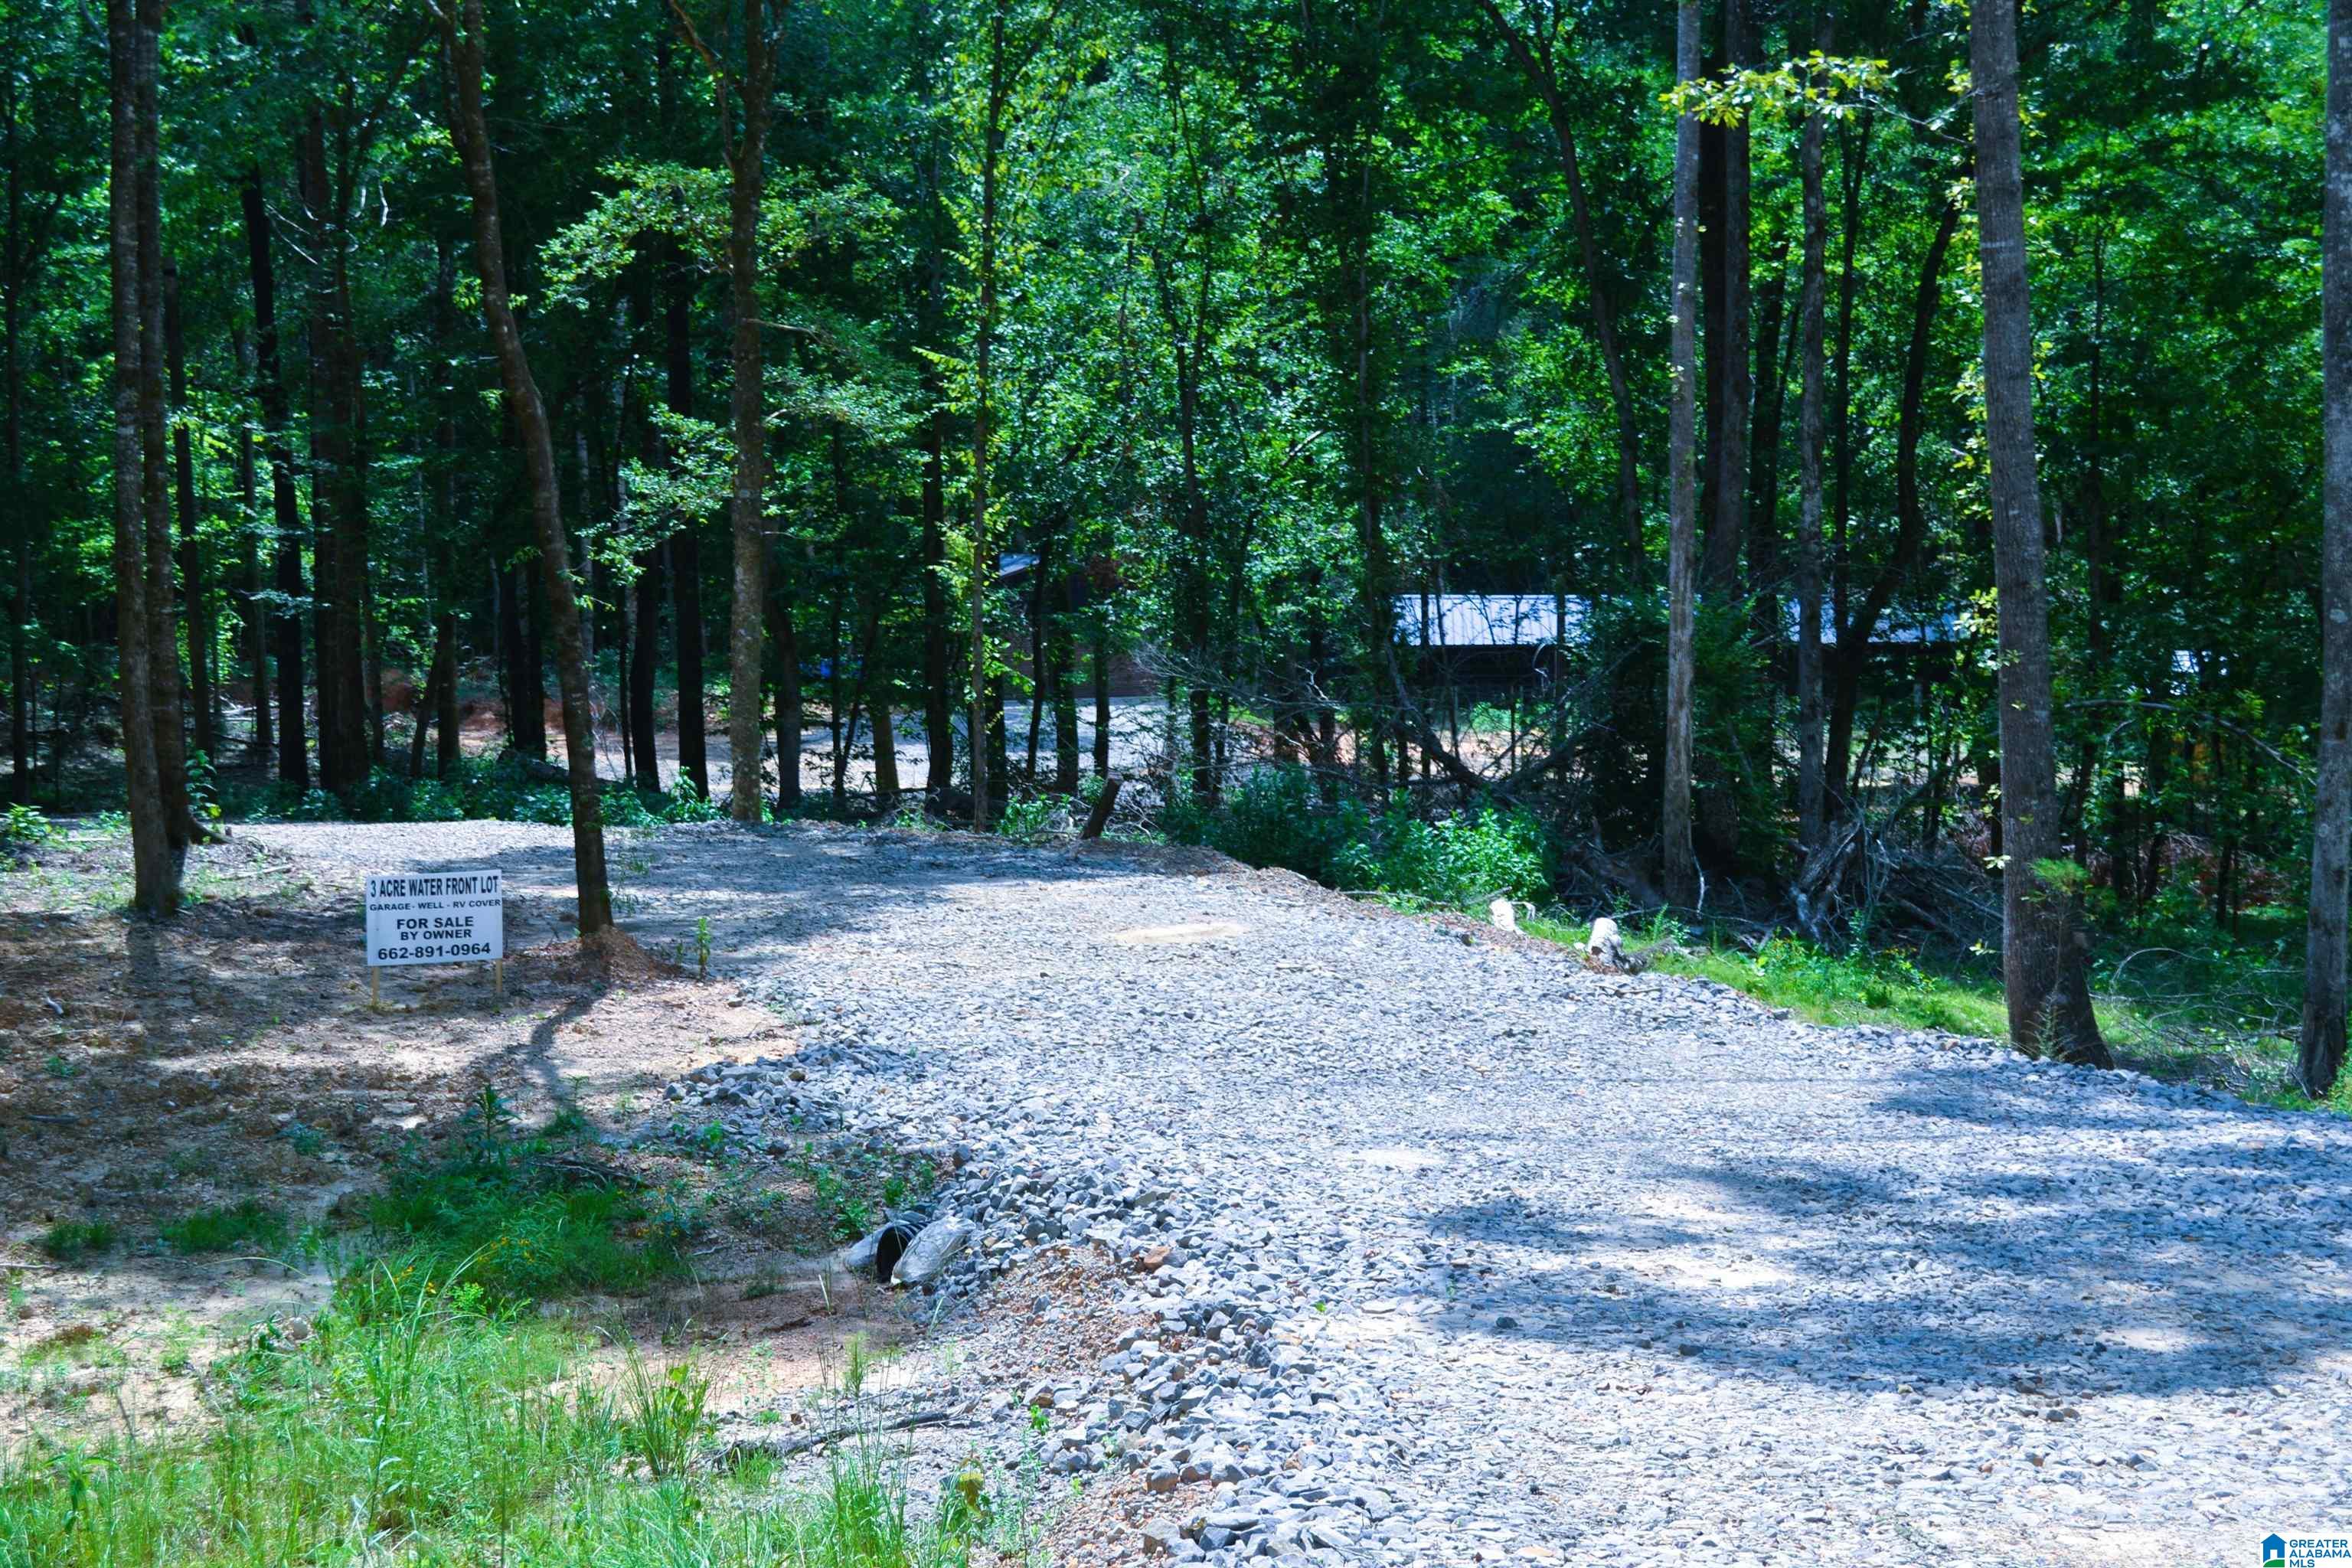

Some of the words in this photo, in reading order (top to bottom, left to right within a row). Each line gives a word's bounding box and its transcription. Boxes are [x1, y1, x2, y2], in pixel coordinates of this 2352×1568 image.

[371, 880, 377, 897] 3
[380, 879, 406, 897] ACRE
[409, 877, 443, 897] WATER
[446, 877, 478, 895] FRONT
[480, 875, 498, 893] LOT
[469, 899, 501, 907] COVER
[397, 918, 429, 929] FOR
[434, 916, 474, 928] SALE
[400, 931, 418, 941] BY
[423, 929, 472, 939] OWNER
[377, 942, 492, 960] 662-891-0964
